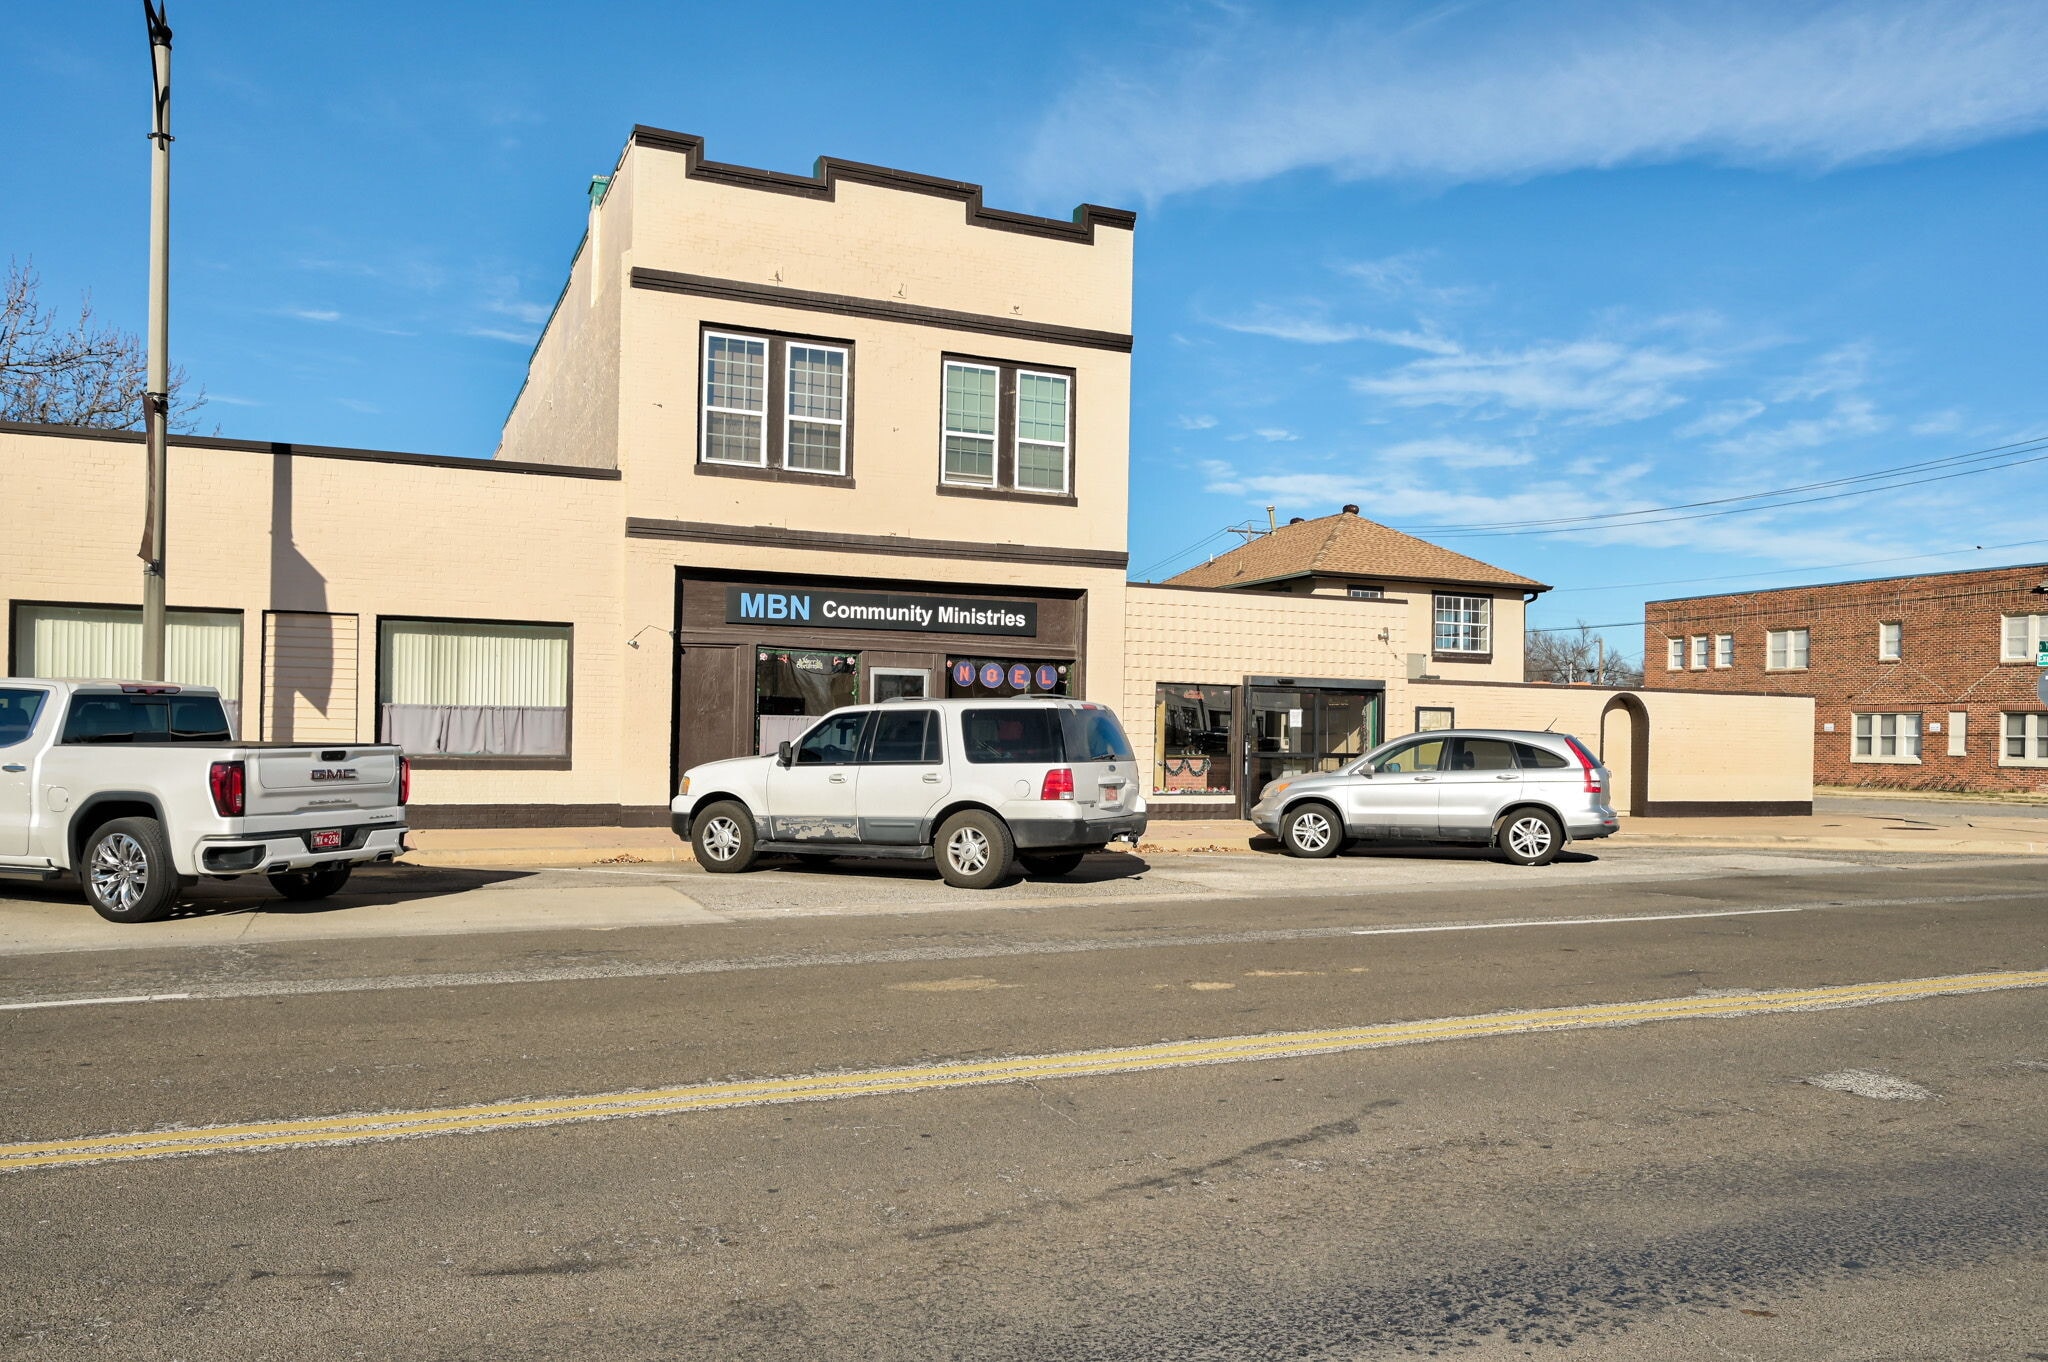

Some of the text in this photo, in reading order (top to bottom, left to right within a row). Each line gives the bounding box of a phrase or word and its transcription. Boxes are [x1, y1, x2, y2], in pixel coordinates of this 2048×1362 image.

[740, 592, 1026, 627] MBN Community Ministries
[311, 768, 356, 780] GMC
